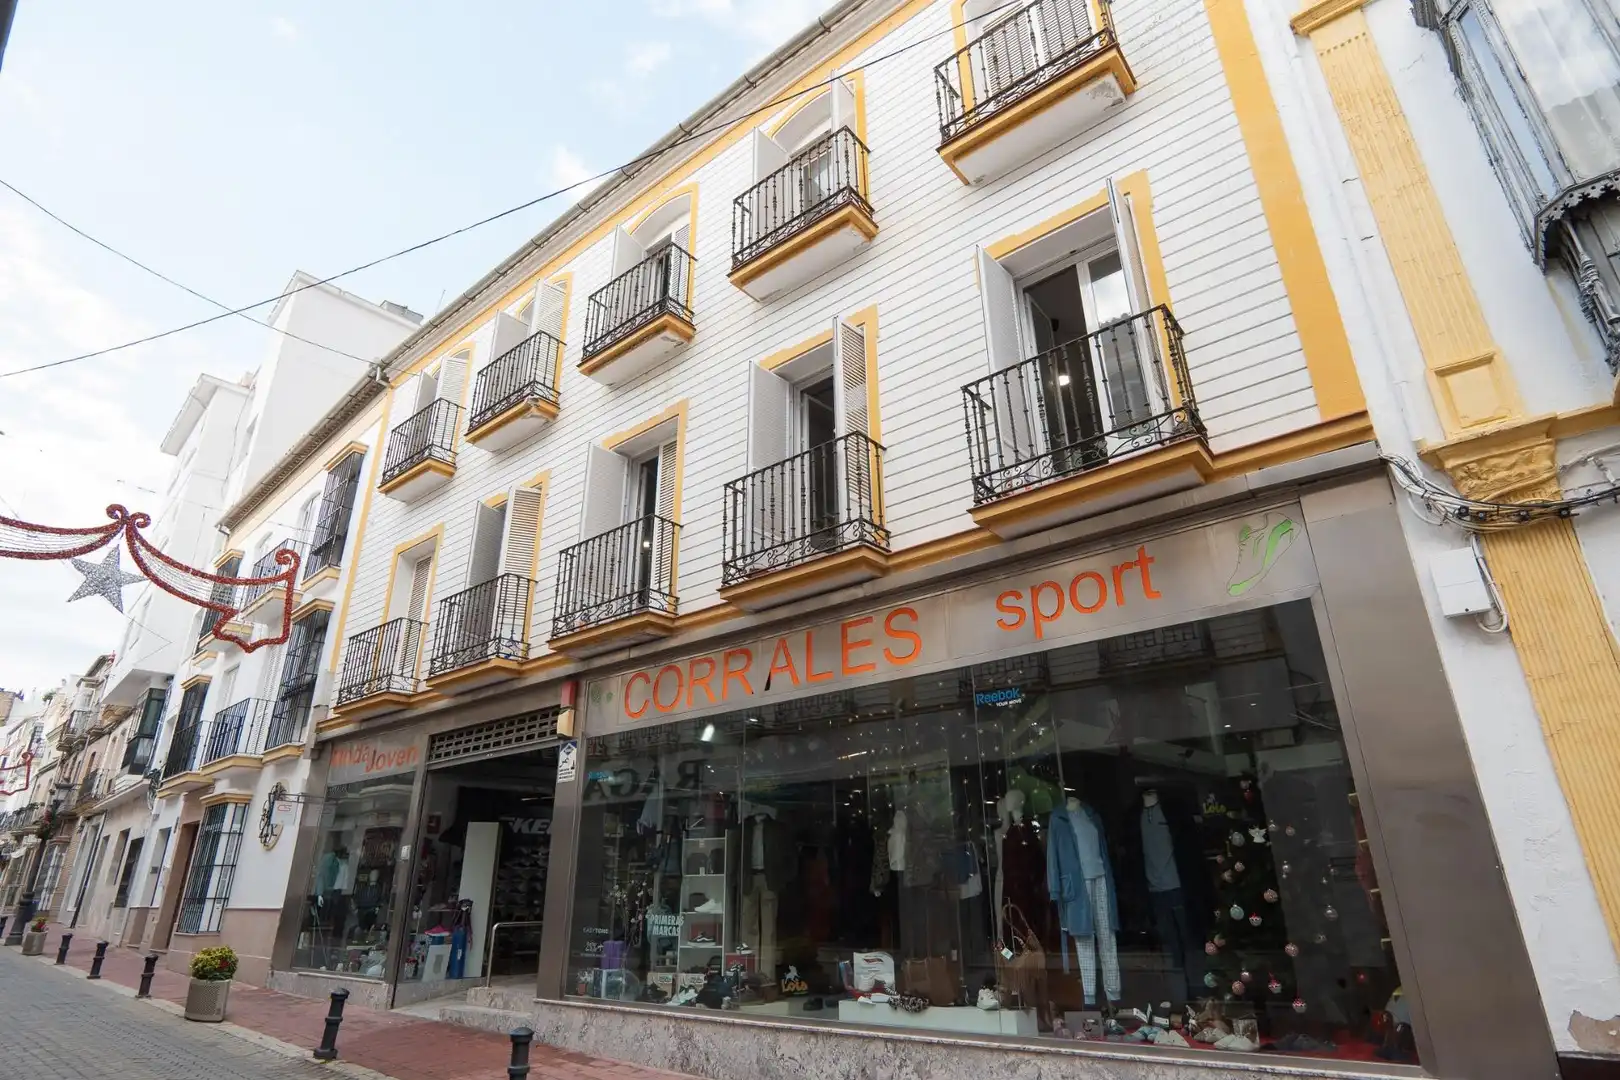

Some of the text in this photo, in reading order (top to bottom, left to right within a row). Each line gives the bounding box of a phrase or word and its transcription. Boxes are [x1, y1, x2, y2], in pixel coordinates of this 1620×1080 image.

[624, 546, 1163, 720] CORRALES sport
[976, 687, 1019, 705] Reebok
[649, 915, 684, 926] PRIMERAS
[652, 925, 680, 937] MARCAS
